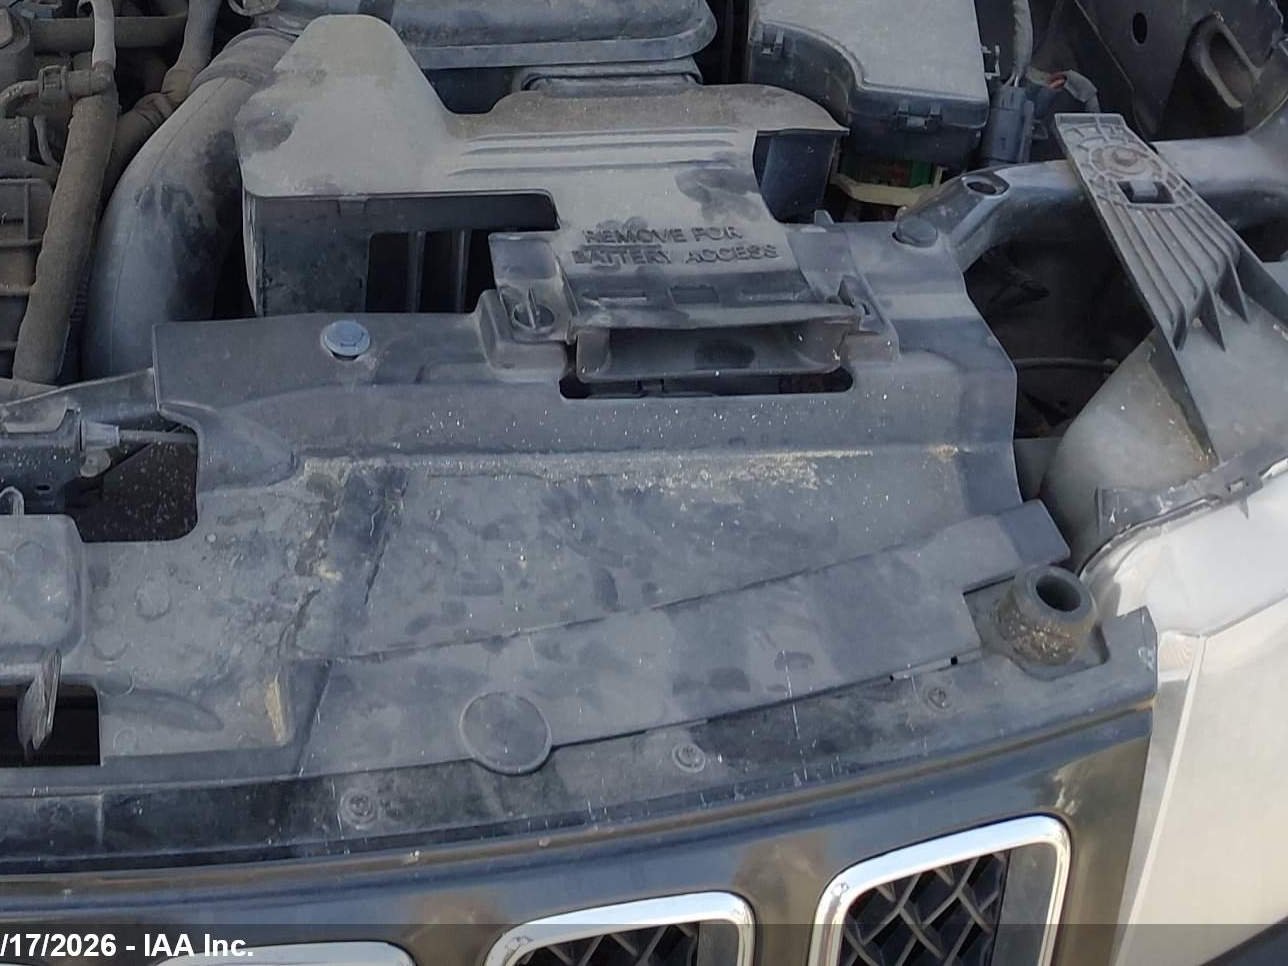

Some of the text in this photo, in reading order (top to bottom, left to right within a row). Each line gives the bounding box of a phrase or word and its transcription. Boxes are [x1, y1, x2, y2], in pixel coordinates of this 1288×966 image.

[583, 225, 743, 244] REMOVE FOR
[572, 244, 779, 265] BATTERY ACCESS
